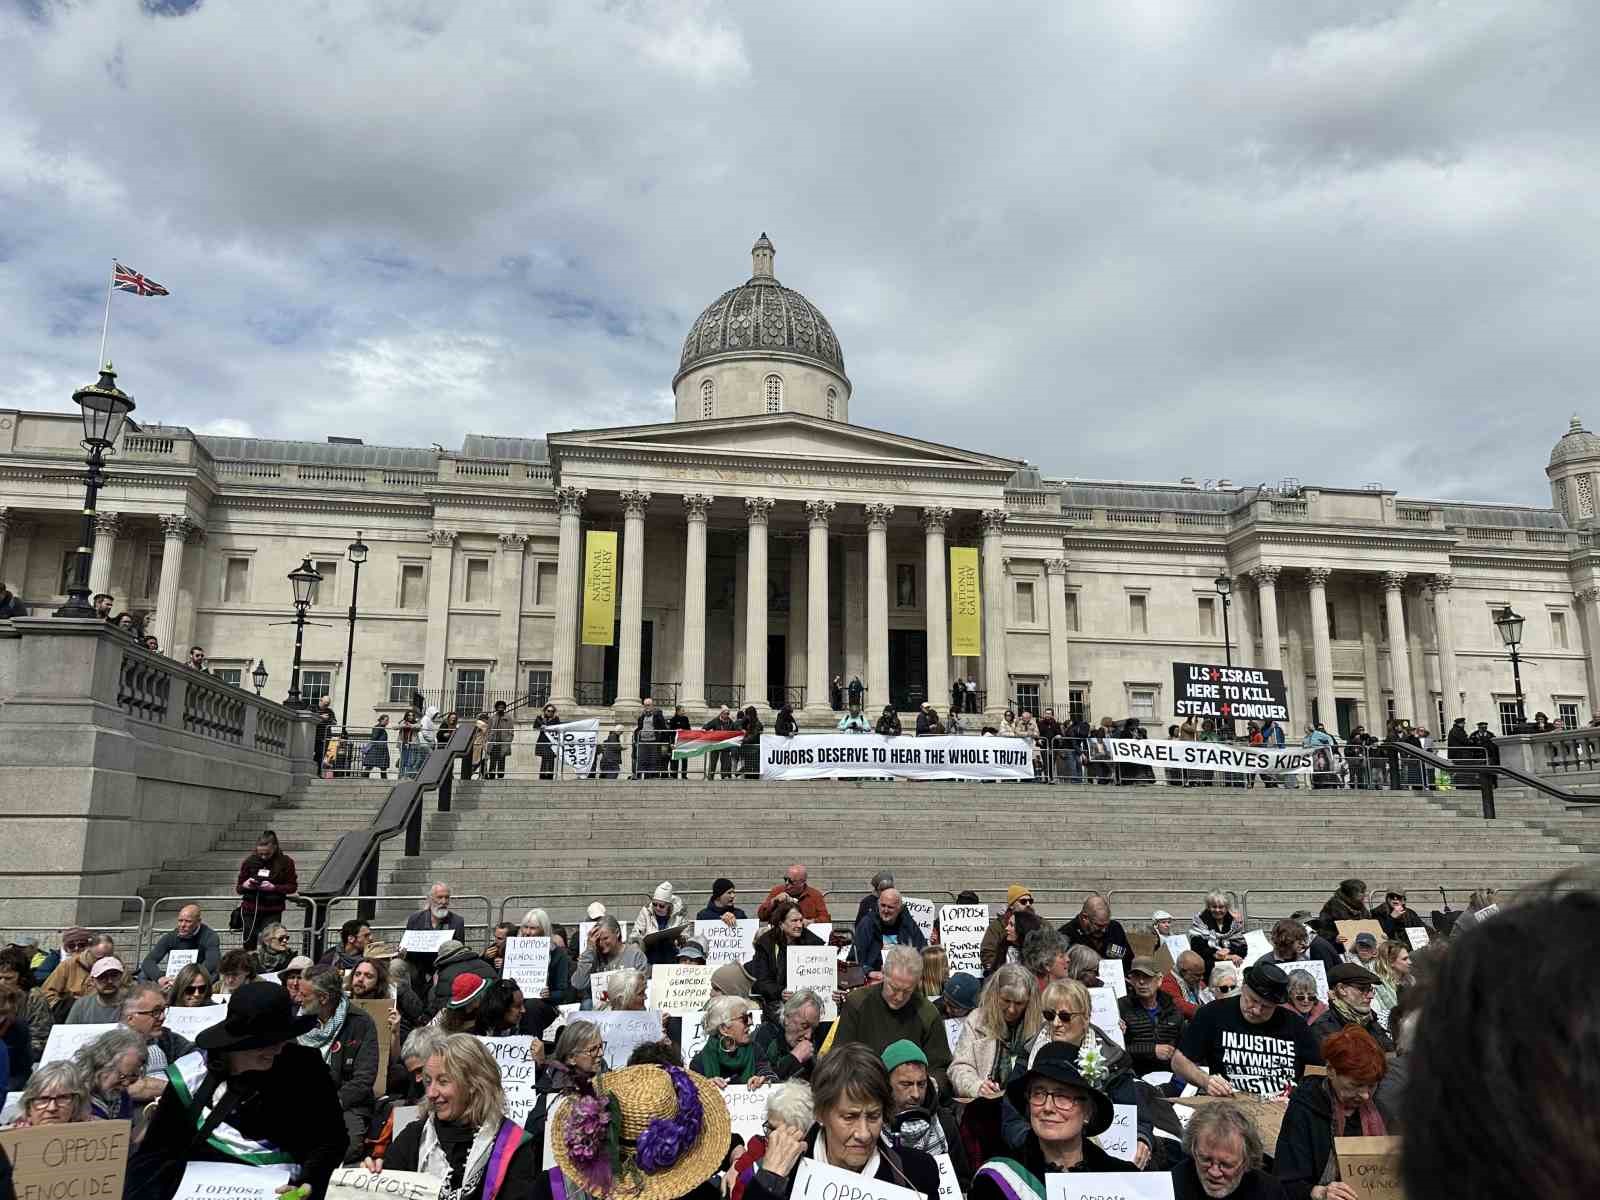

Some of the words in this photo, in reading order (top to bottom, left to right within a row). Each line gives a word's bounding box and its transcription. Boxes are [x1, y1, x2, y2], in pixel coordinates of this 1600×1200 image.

[592, 550, 602, 601] NATIONAL
[601, 550, 612, 602] GALLERY
[1219, 668, 1269, 685] ISRAEL
[1186, 683, 1220, 699] HERE
[1222, 685, 1240, 700] TO
[1242, 686, 1275, 701] KILL
[1176, 700, 1221, 716] STEAL
[1230, 703, 1287, 719] CONQUER
[767, 749, 814, 765] JURORS
[817, 747, 869, 763] DESERVE
[871, 747, 887, 763] TO
[890, 748, 921, 764] HEAR
[925, 749, 945, 764] THE
[948, 749, 990, 765] WHOLE
[993, 749, 1027, 766] TRUTH
[1112, 742, 1180, 762] ISRAEL
[1184, 747, 1269, 769] STARVES
[1274, 753, 1312, 769] KIDS
[949, 941, 980, 951] SUPPOR
[692, 1023, 701, 1039] I
[1222, 1031, 1296, 1056] INJUSTICE
[1222, 1048, 1296, 1068] ANYWHERE
[1246, 1066, 1282, 1077] THREAT
[42, 1132, 125, 1168] OPPOSE
[335, 1169, 354, 1187] I
[194, 1183, 203, 1194] I
[206, 1184, 264, 1195] OPPOSE
